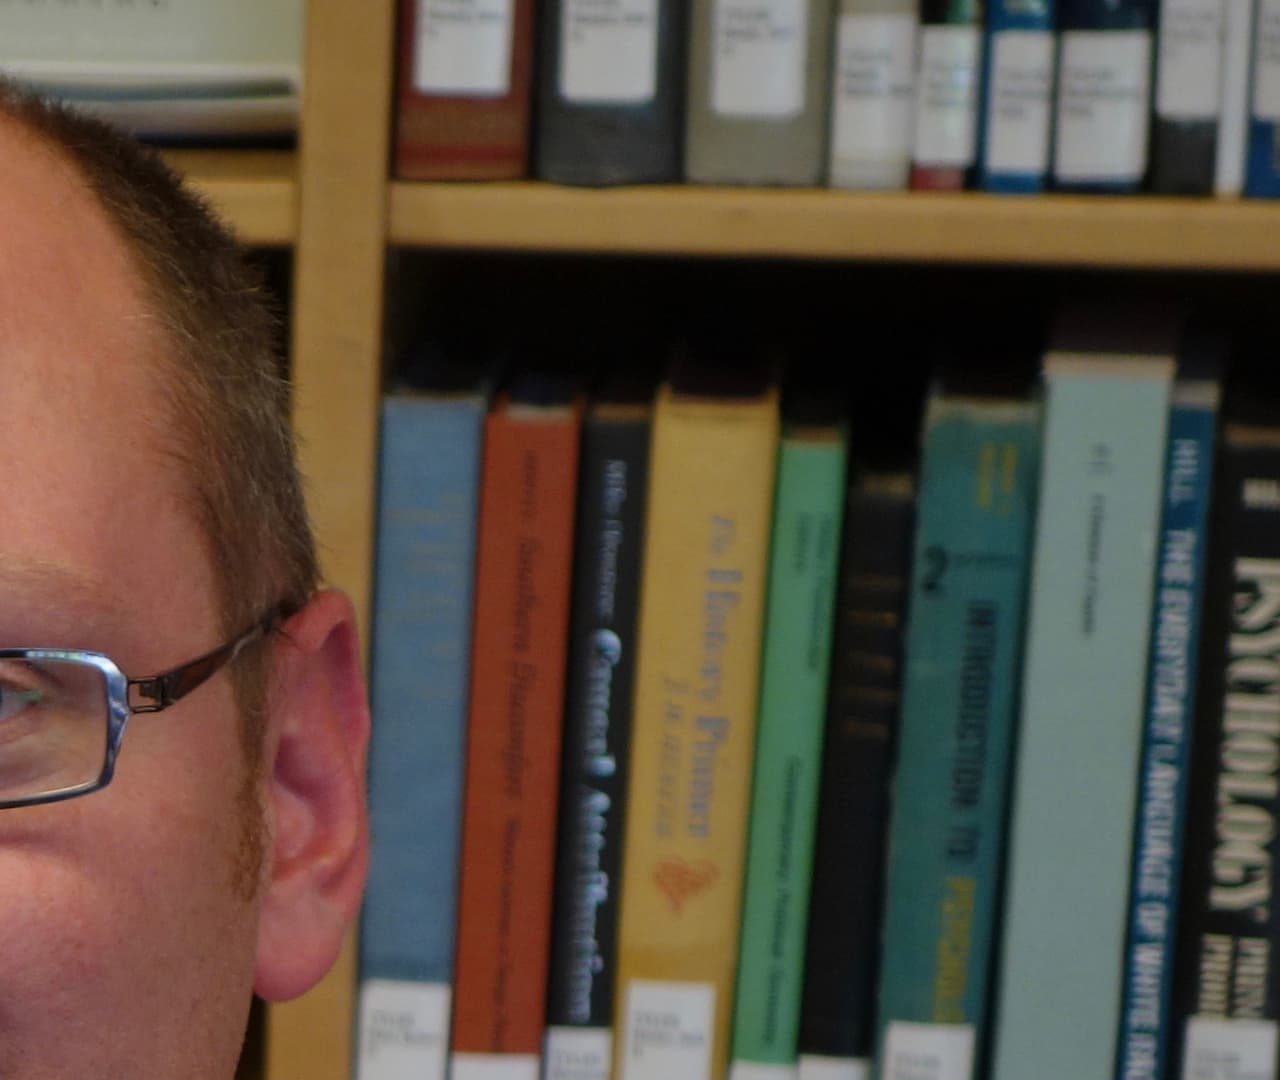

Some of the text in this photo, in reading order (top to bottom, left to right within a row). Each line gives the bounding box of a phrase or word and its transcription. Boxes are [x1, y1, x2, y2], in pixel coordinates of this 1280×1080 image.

[1161, 530, 1204, 588] THE
[949, 600, 1000, 809] INTRODUCTION
[1207, 557, 1280, 913] PSYCHOLOGY
[686, 714, 732, 839] Primer
[1137, 742, 1185, 893] LANGUAGE
[945, 825, 985, 864] TO
[1135, 901, 1169, 938] OF
[1127, 942, 1166, 1026] WHITE
